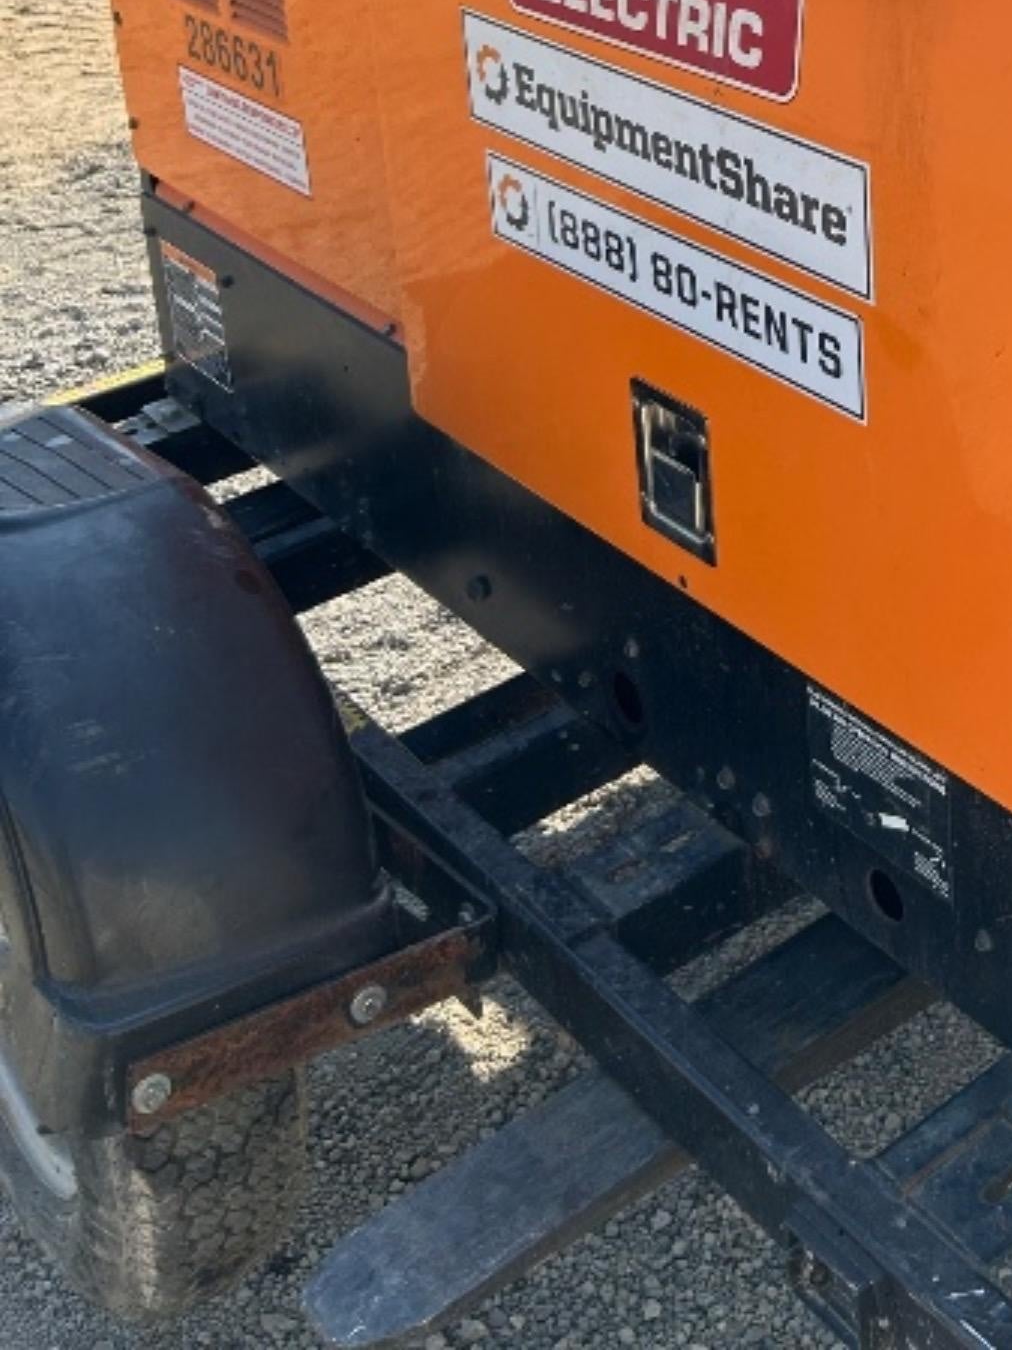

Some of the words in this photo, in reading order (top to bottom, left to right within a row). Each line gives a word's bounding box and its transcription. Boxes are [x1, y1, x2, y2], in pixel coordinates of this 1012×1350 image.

[184, 14, 284, 98] 286631
[512, 62, 848, 247] EquipmentShare
[548, 200, 639, 284] (888)
[650, 251, 843, 380] 80-RENTS
